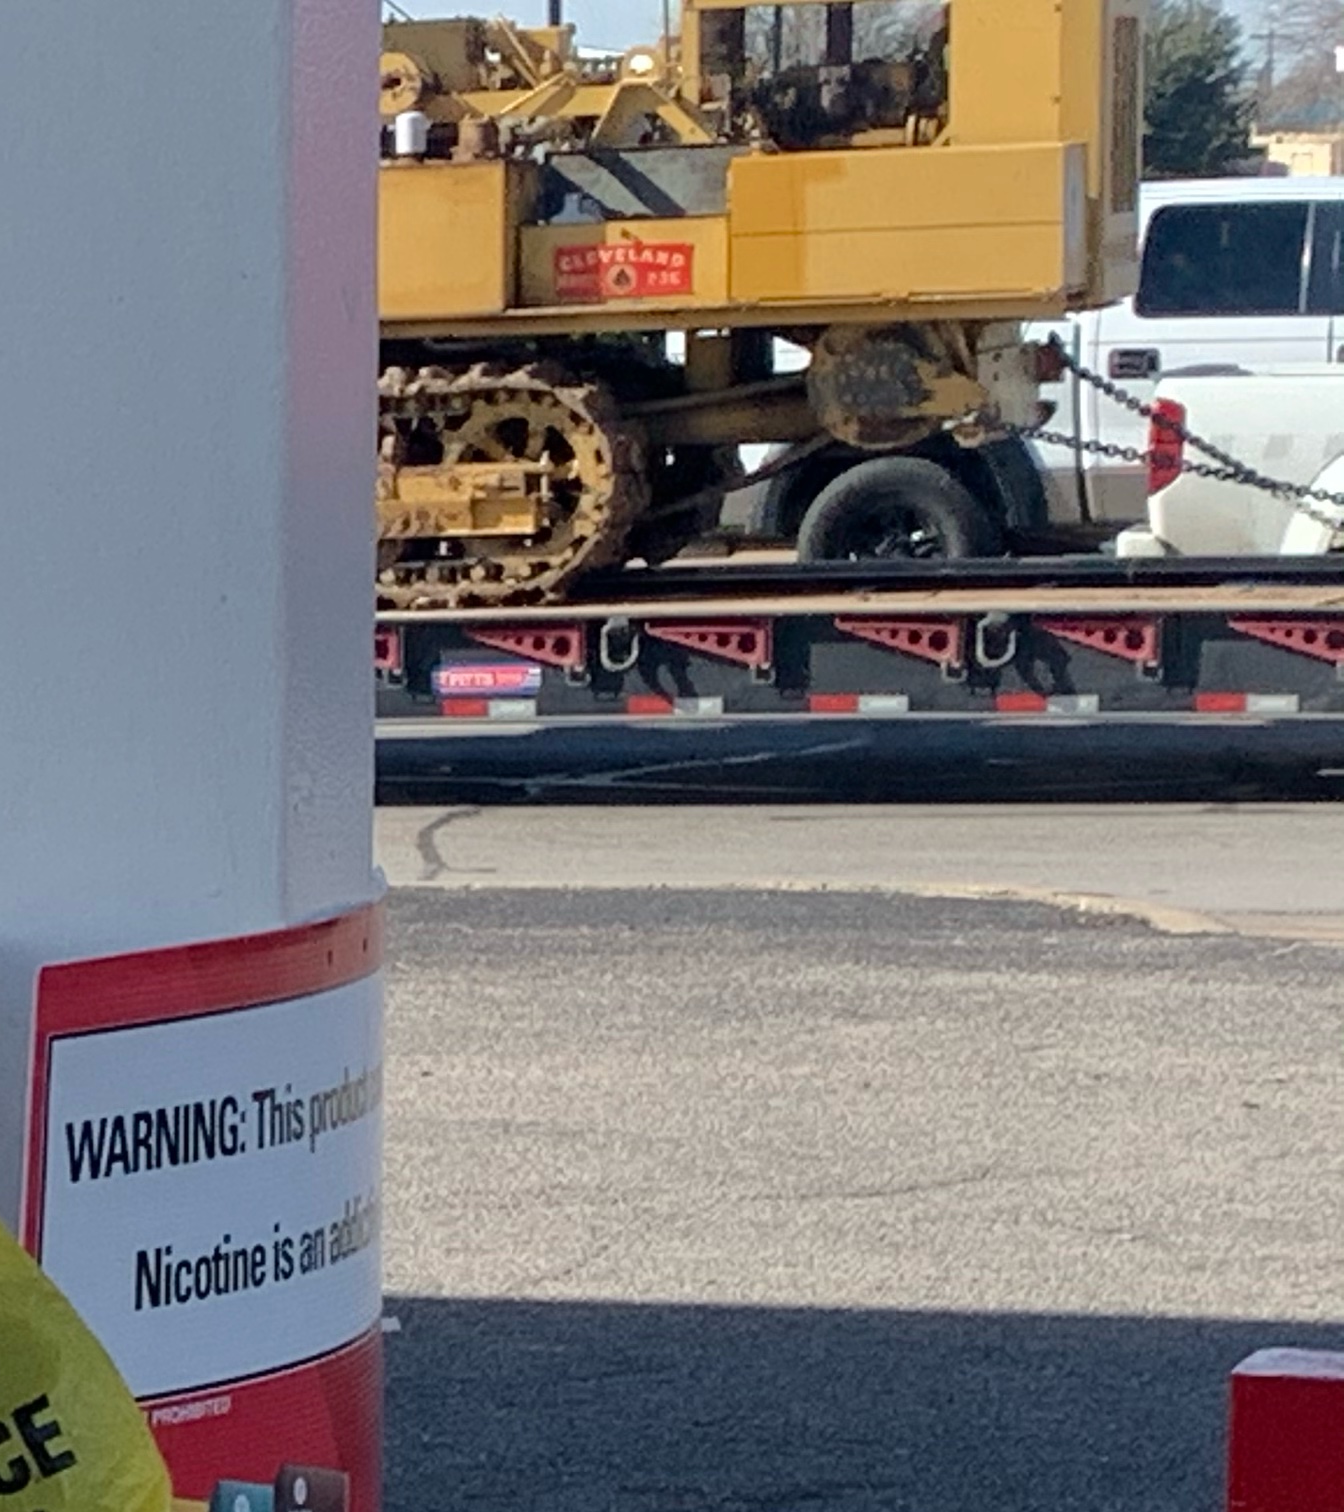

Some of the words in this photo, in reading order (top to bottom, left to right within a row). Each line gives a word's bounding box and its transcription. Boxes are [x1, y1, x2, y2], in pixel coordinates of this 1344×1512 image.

[558, 248, 686, 271] CLEVELAND
[65, 1094, 248, 1183] WARNING:
[252, 1082, 305, 1151] This
[309, 1062, 380, 1154] produ
[134, 1233, 266, 1311] Nicotine
[273, 1222, 295, 1283] is
[299, 1226, 325, 1275] an
